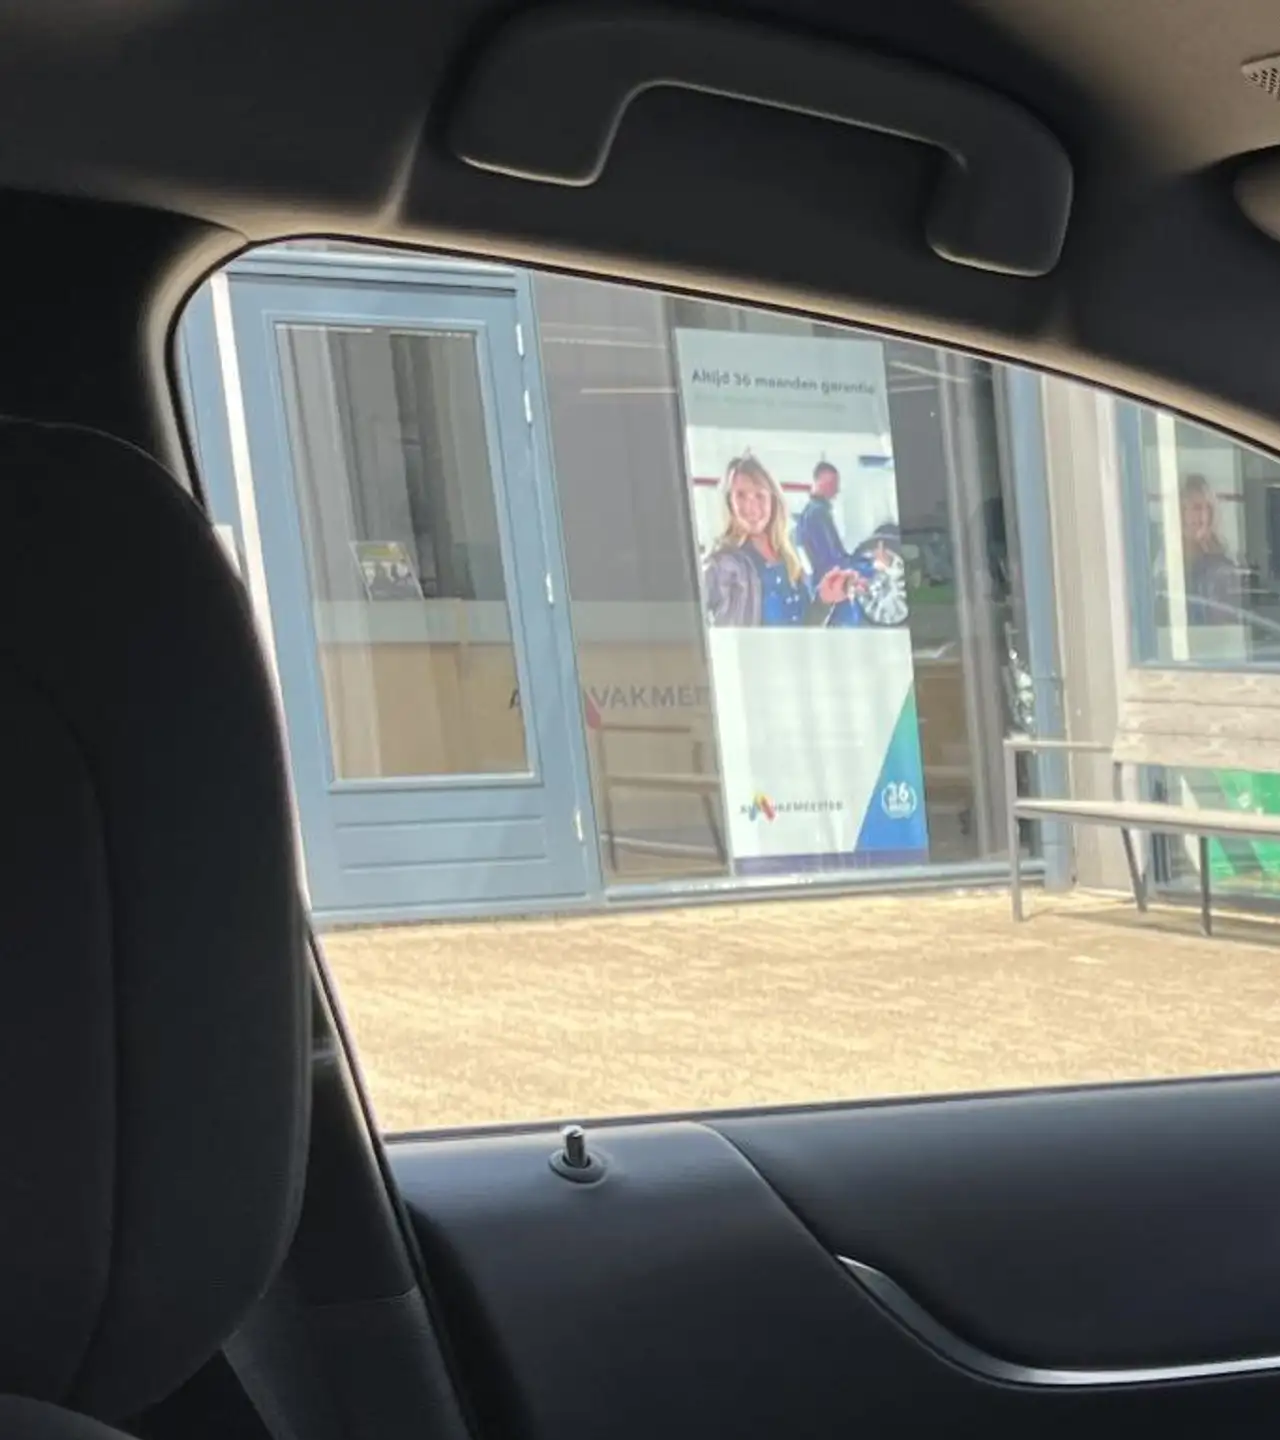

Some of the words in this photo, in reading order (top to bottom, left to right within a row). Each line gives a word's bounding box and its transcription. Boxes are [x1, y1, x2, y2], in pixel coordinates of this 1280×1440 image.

[692, 367, 730, 388] Altijd
[733, 373, 752, 387] 36
[755, 376, 818, 391] maanden
[821, 380, 877, 396] garantie
